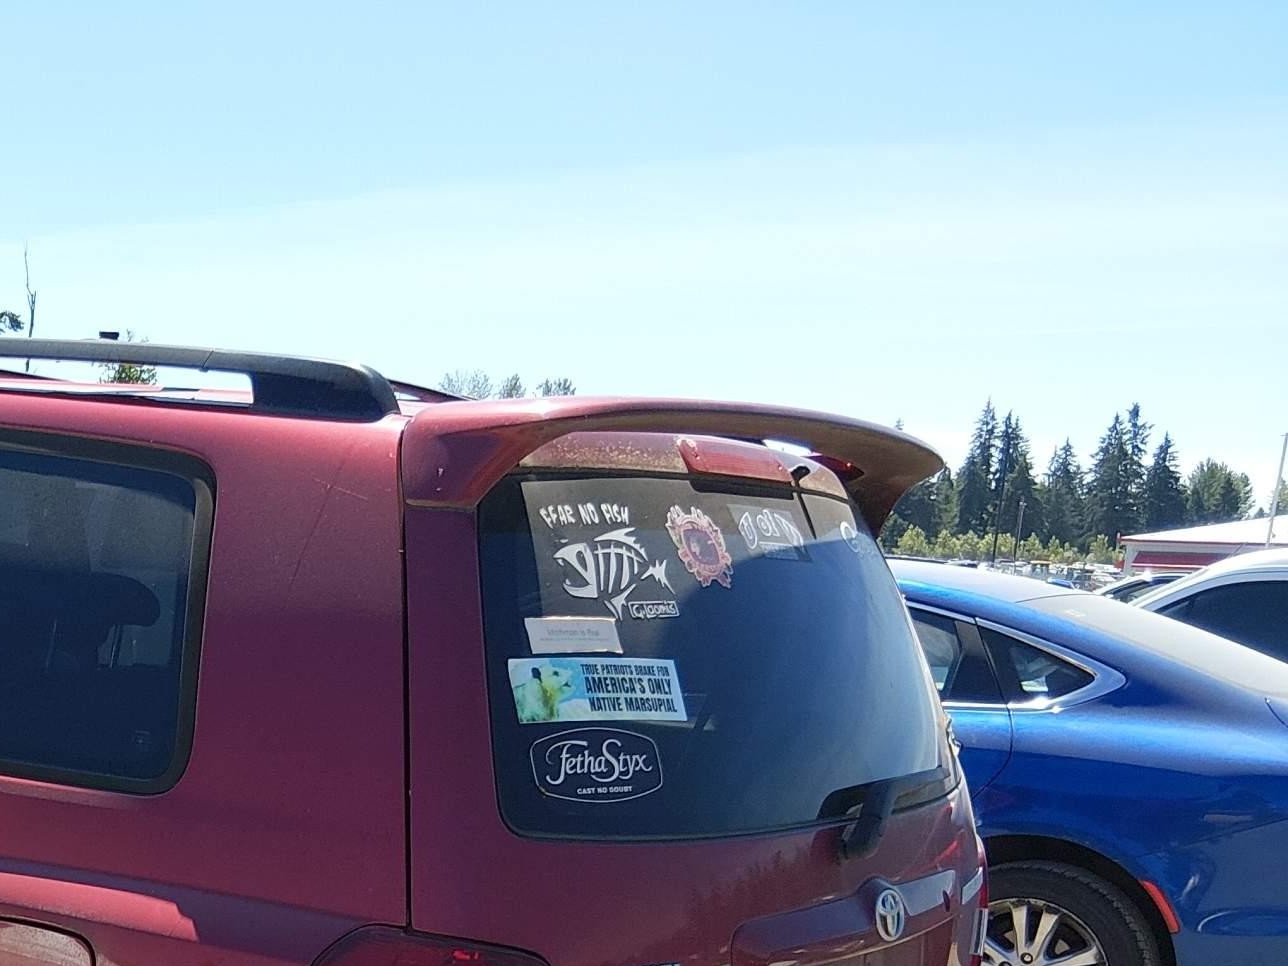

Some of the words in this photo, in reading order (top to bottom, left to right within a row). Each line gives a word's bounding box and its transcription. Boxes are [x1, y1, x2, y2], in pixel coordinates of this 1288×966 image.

[578, 502, 599, 525] NO
[601, 503, 630, 525] FISH
[580, 664, 600, 675] TRUE
[600, 664, 632, 676] PATRIOTS
[633, 665, 657, 676] BRAKE
[657, 666, 670, 677] FOR
[584, 676, 646, 694] AMERICA'S
[647, 678, 672, 695] ONLY
[588, 697, 623, 712] NATIVE
[624, 697, 678, 713] MARSUPIAL
